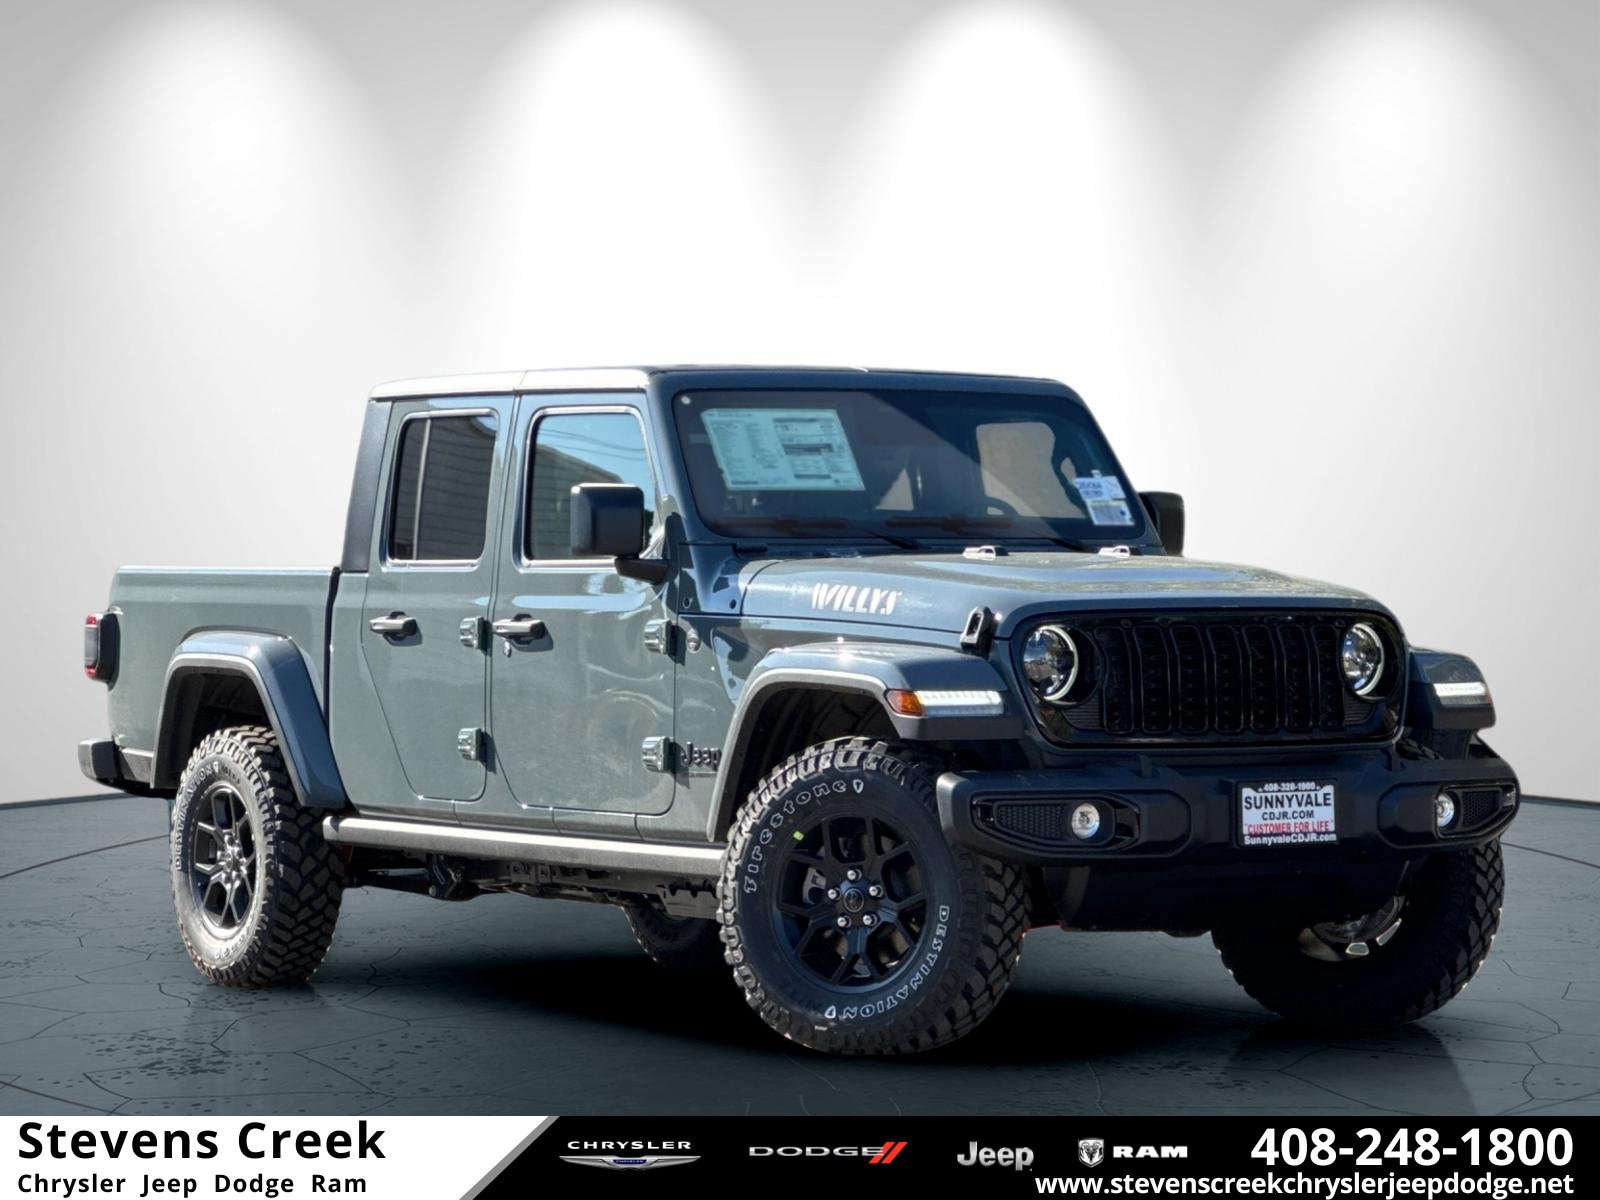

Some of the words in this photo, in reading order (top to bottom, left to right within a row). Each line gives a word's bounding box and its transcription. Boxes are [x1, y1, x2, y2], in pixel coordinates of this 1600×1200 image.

[811, 583, 902, 615] WILLYS
[680, 741, 722, 772] Jeep
[1244, 793, 1332, 810] SUNNYVALE
[1261, 810, 1314, 821] CDJR.COM
[1294, 822, 1310, 833] FOR
[1244, 833, 1337, 846] SunnyvaleCDJR.com
[842, 904, 951, 1020] DESTINATION
